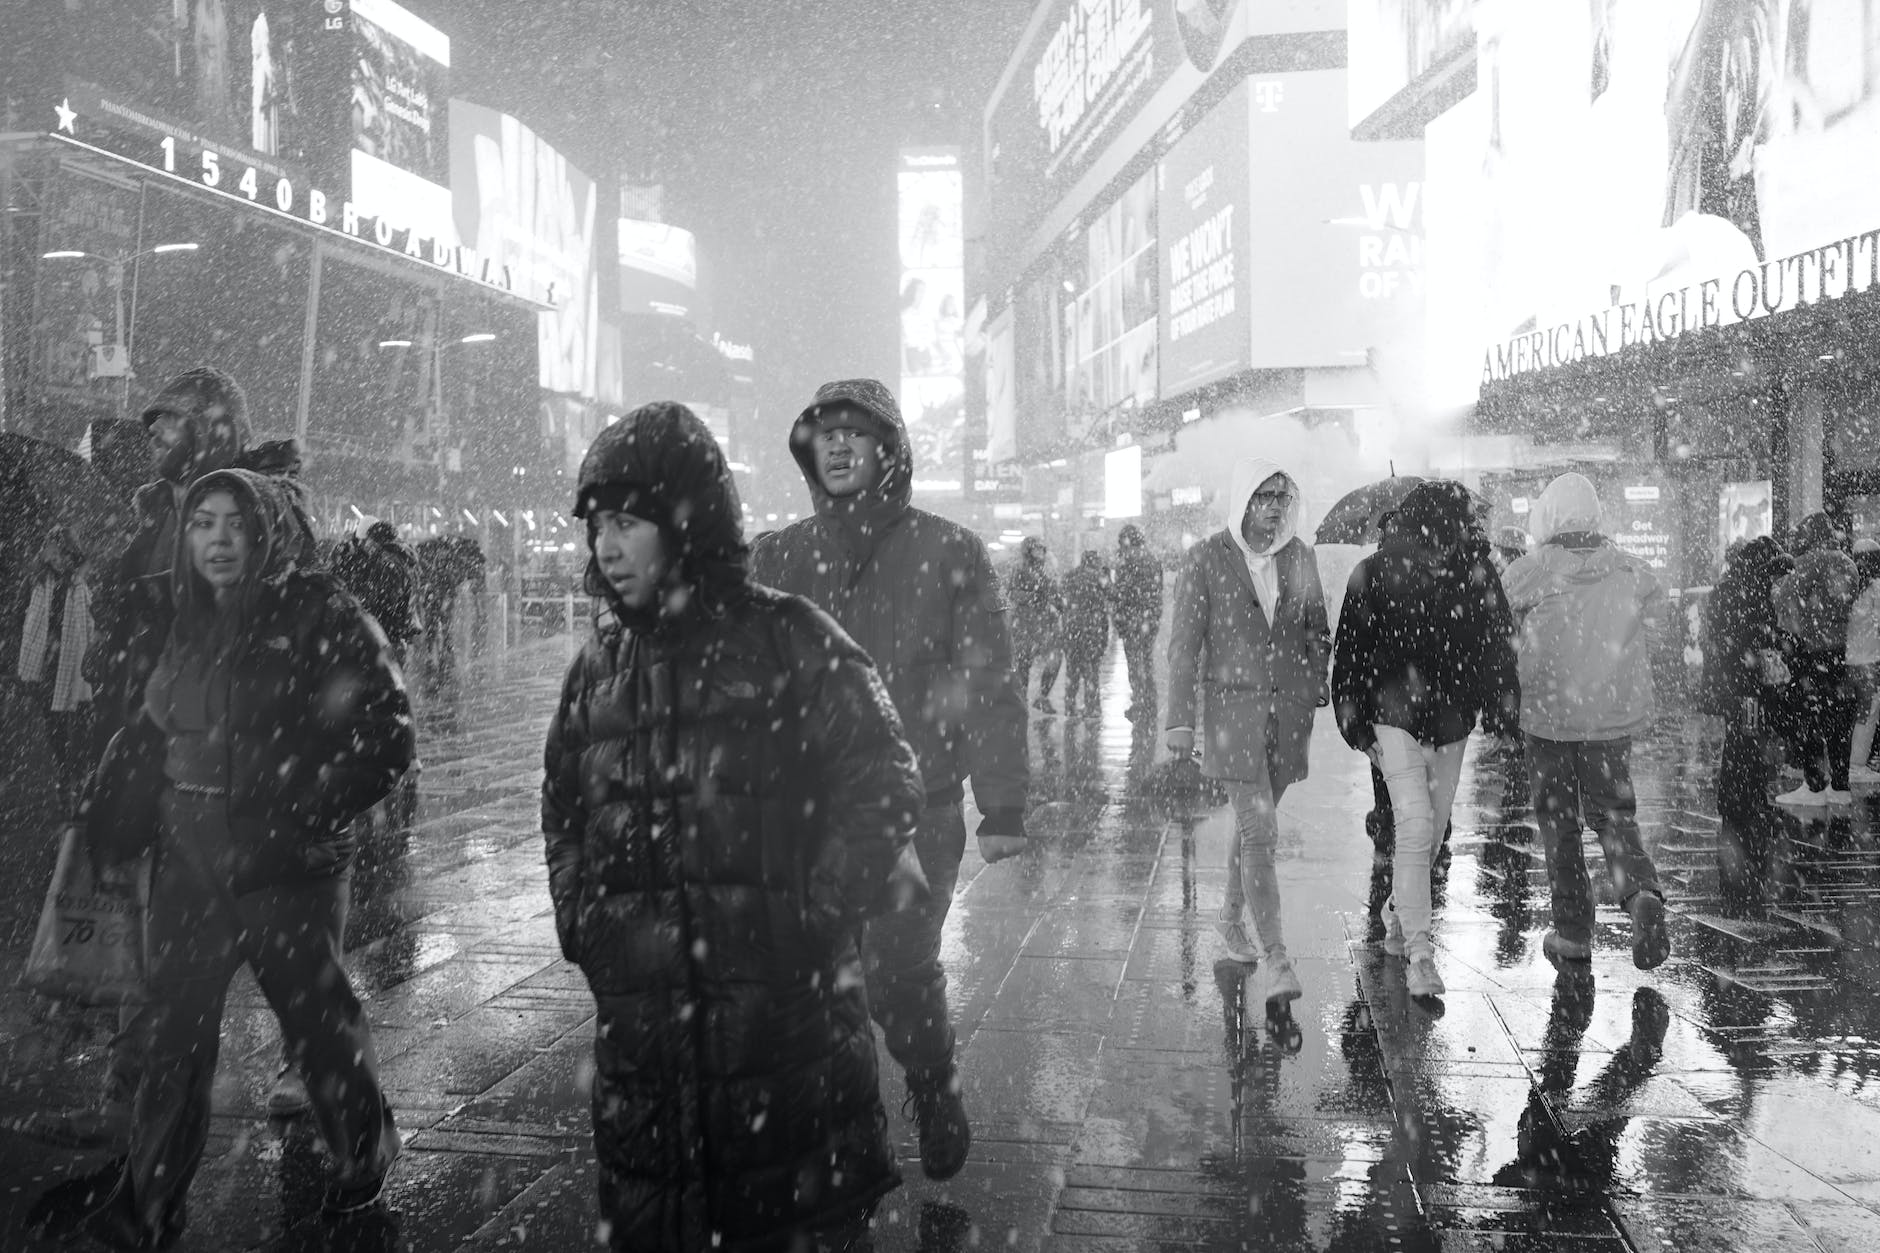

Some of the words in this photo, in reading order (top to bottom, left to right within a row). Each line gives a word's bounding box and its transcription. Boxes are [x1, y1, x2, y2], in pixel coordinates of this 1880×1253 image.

[325, 17, 343, 30] LG
[159, 135, 293, 212] 1540
[1360, 182, 1426, 231] W
[1360, 271, 1400, 299] OF
[1481, 308, 1613, 386] AMERICAN
[1621, 276, 1722, 350] EAGLE
